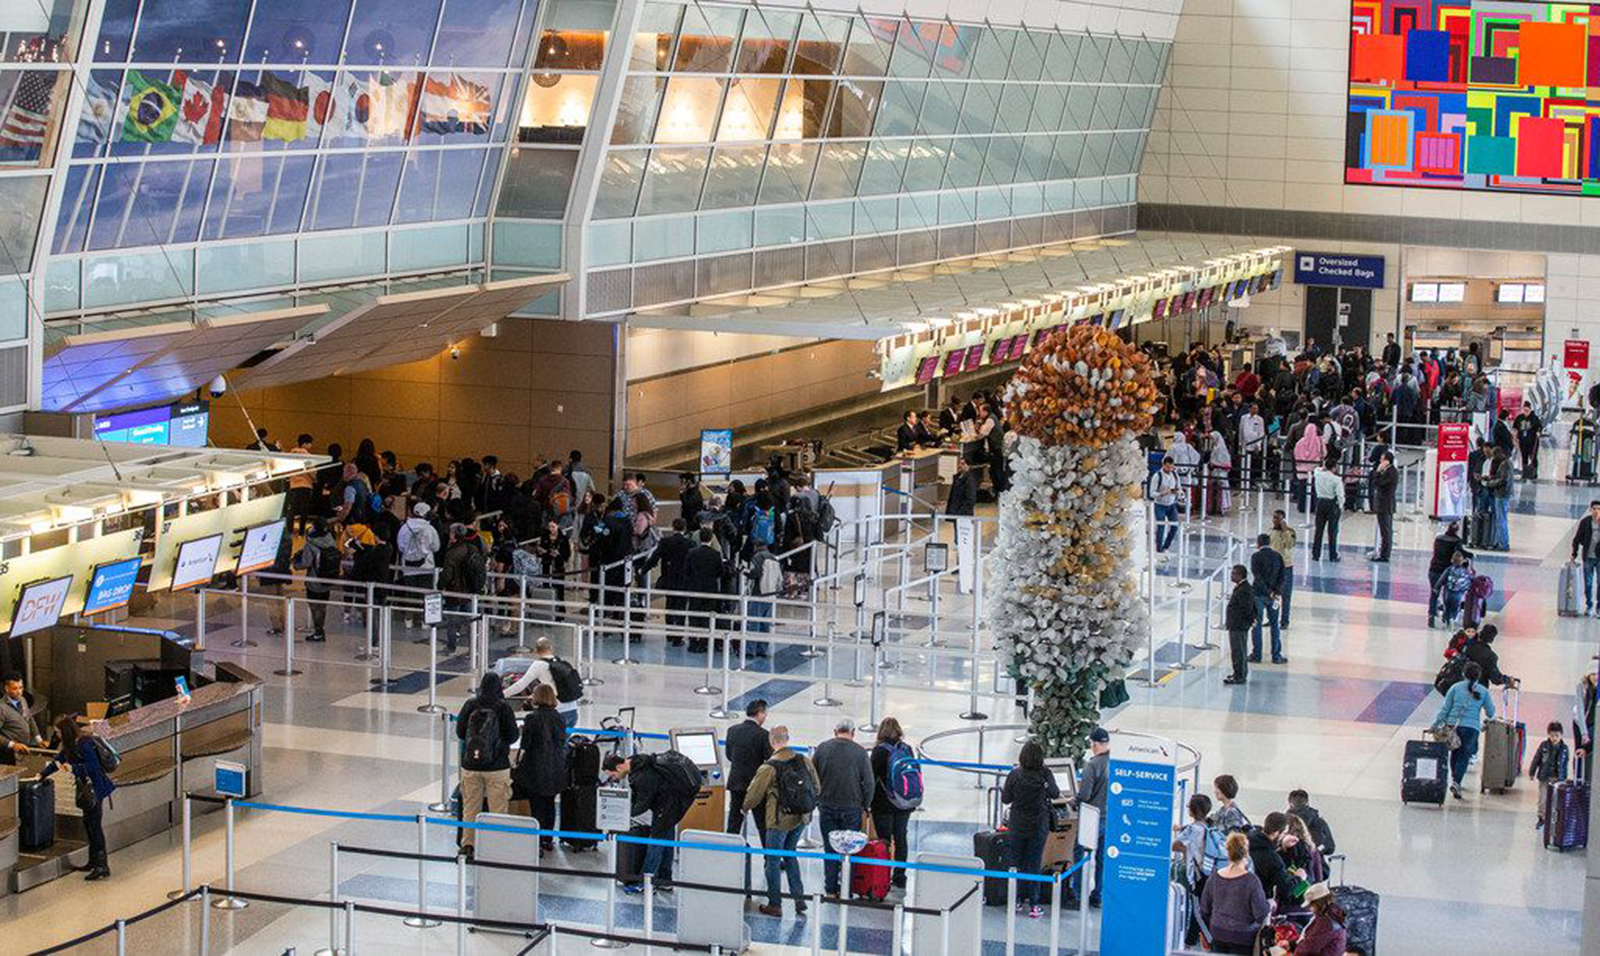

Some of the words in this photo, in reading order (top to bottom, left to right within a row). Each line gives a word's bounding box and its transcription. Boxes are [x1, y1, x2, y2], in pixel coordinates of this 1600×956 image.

[1319, 257, 1359, 267] Oversized
[1318, 266, 1353, 276] Checked
[1354, 268, 1375, 279] Bags
[161, 522, 172, 535] 37
[20, 590, 63, 623] DFW
[1128, 745, 1160, 754] American
[1114, 768, 1169, 781] SELF-SERVICE
